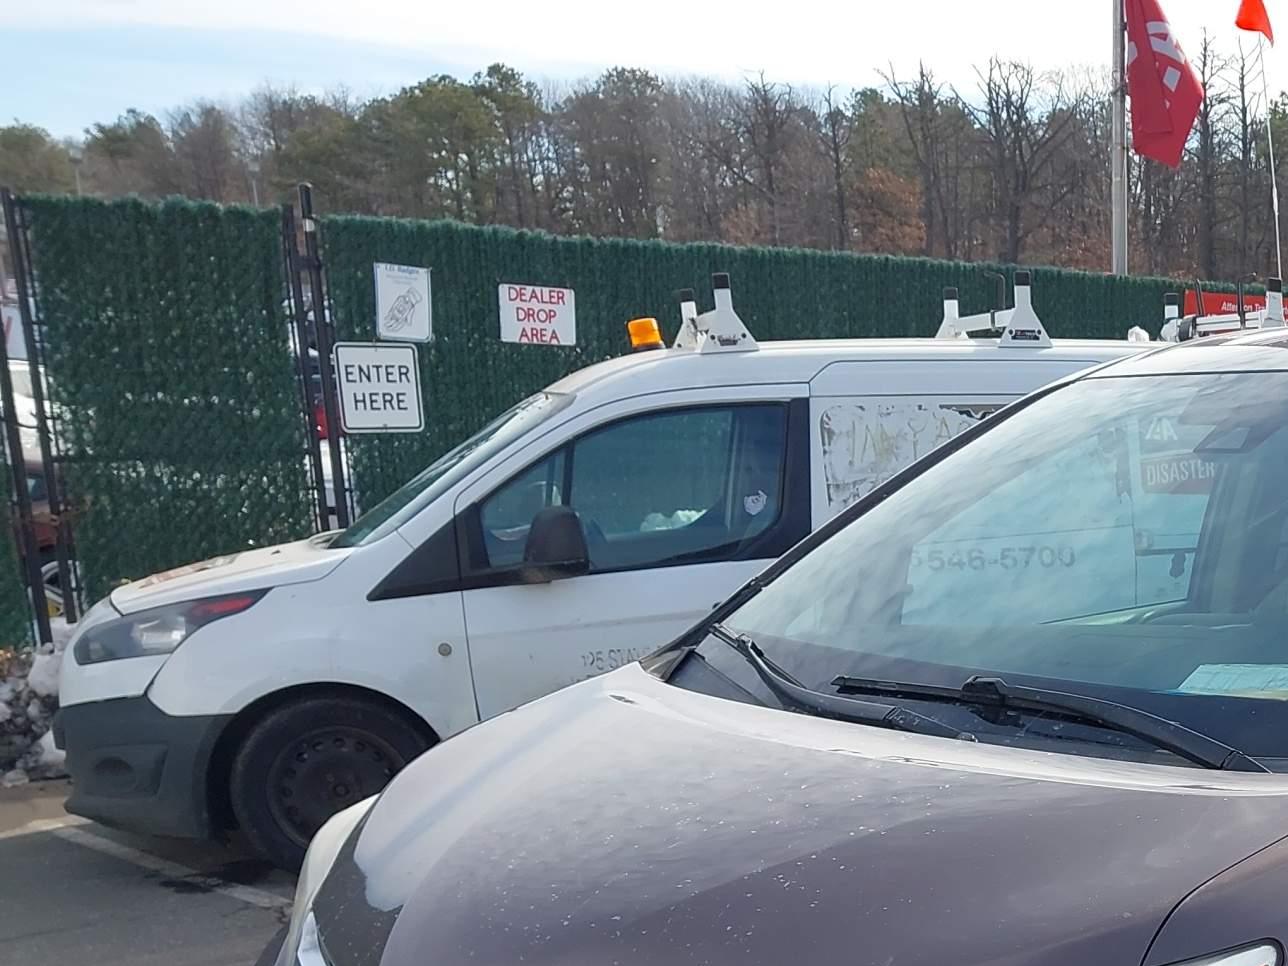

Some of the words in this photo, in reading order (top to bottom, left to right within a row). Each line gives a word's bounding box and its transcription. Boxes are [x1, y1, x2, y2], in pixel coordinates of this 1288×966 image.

[508, 287, 566, 305] DEALER
[1221, 300, 1253, 312] Attenon
[516, 307, 557, 324] DROP
[518, 328, 560, 343] AREA
[345, 364, 411, 383] ENTER
[353, 392, 408, 411] HERE
[1146, 459, 1216, 486] DISASTER
